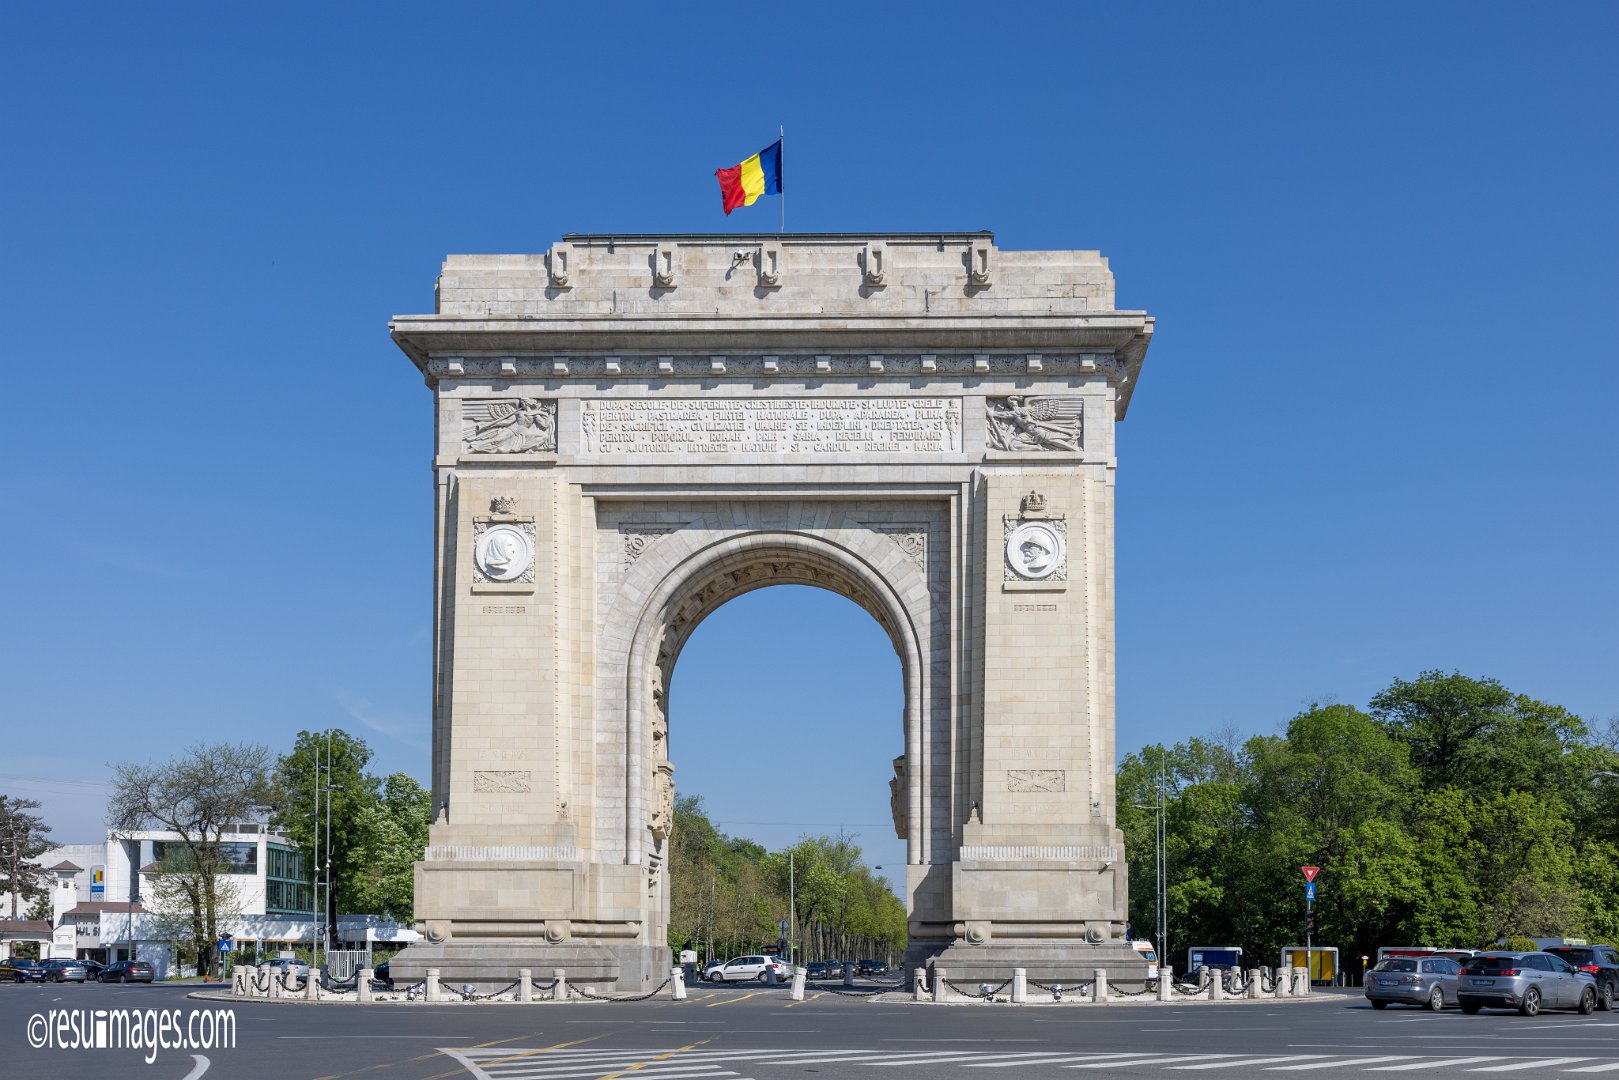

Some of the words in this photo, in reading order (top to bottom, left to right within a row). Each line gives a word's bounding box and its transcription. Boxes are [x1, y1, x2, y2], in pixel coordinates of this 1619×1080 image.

[600, 400, 624, 411] DUPA
[630, 400, 666, 411] SECOLE
[671, 400, 684, 410] DE
[689, 400, 740, 410] SUFERINTE
[862, 400, 872, 410] SI
[877, 400, 907, 410] LUPTE
[913, 400, 943, 409] GRELE
[600, 411, 635, 421] PENTRU
[648, 411, 702, 421] PASTRAREA
[757, 410, 808, 420] NATIONALE
[820, 410, 843, 420] DUPA
[854, 410, 904, 420] APARAREA
[915, 410, 943, 420] PLINA
[600, 421, 612, 432] DE
[675, 421, 684, 431] A
[755, 421, 786, 431] UMANE
[795, 421, 808, 431] SE
[872, 421, 923, 430] DREPTATEA
[934, 421, 943, 430] SI
[600, 432, 635, 443] PENTRU
[651, 432, 694, 442] POPORUL
[756, 432, 777, 442] PRIN
[836, 431, 874, 442] REGELUI
[890, 431, 942, 441] FERDINAND
[600, 443, 612, 453] CU
[625, 443, 674, 453] AJUTORUL
[791, 442, 800, 452] SI
[814, 442, 851, 452] GANDUL
[865, 442, 900, 452] REGINEI
[914, 442, 944, 452] MARIA
